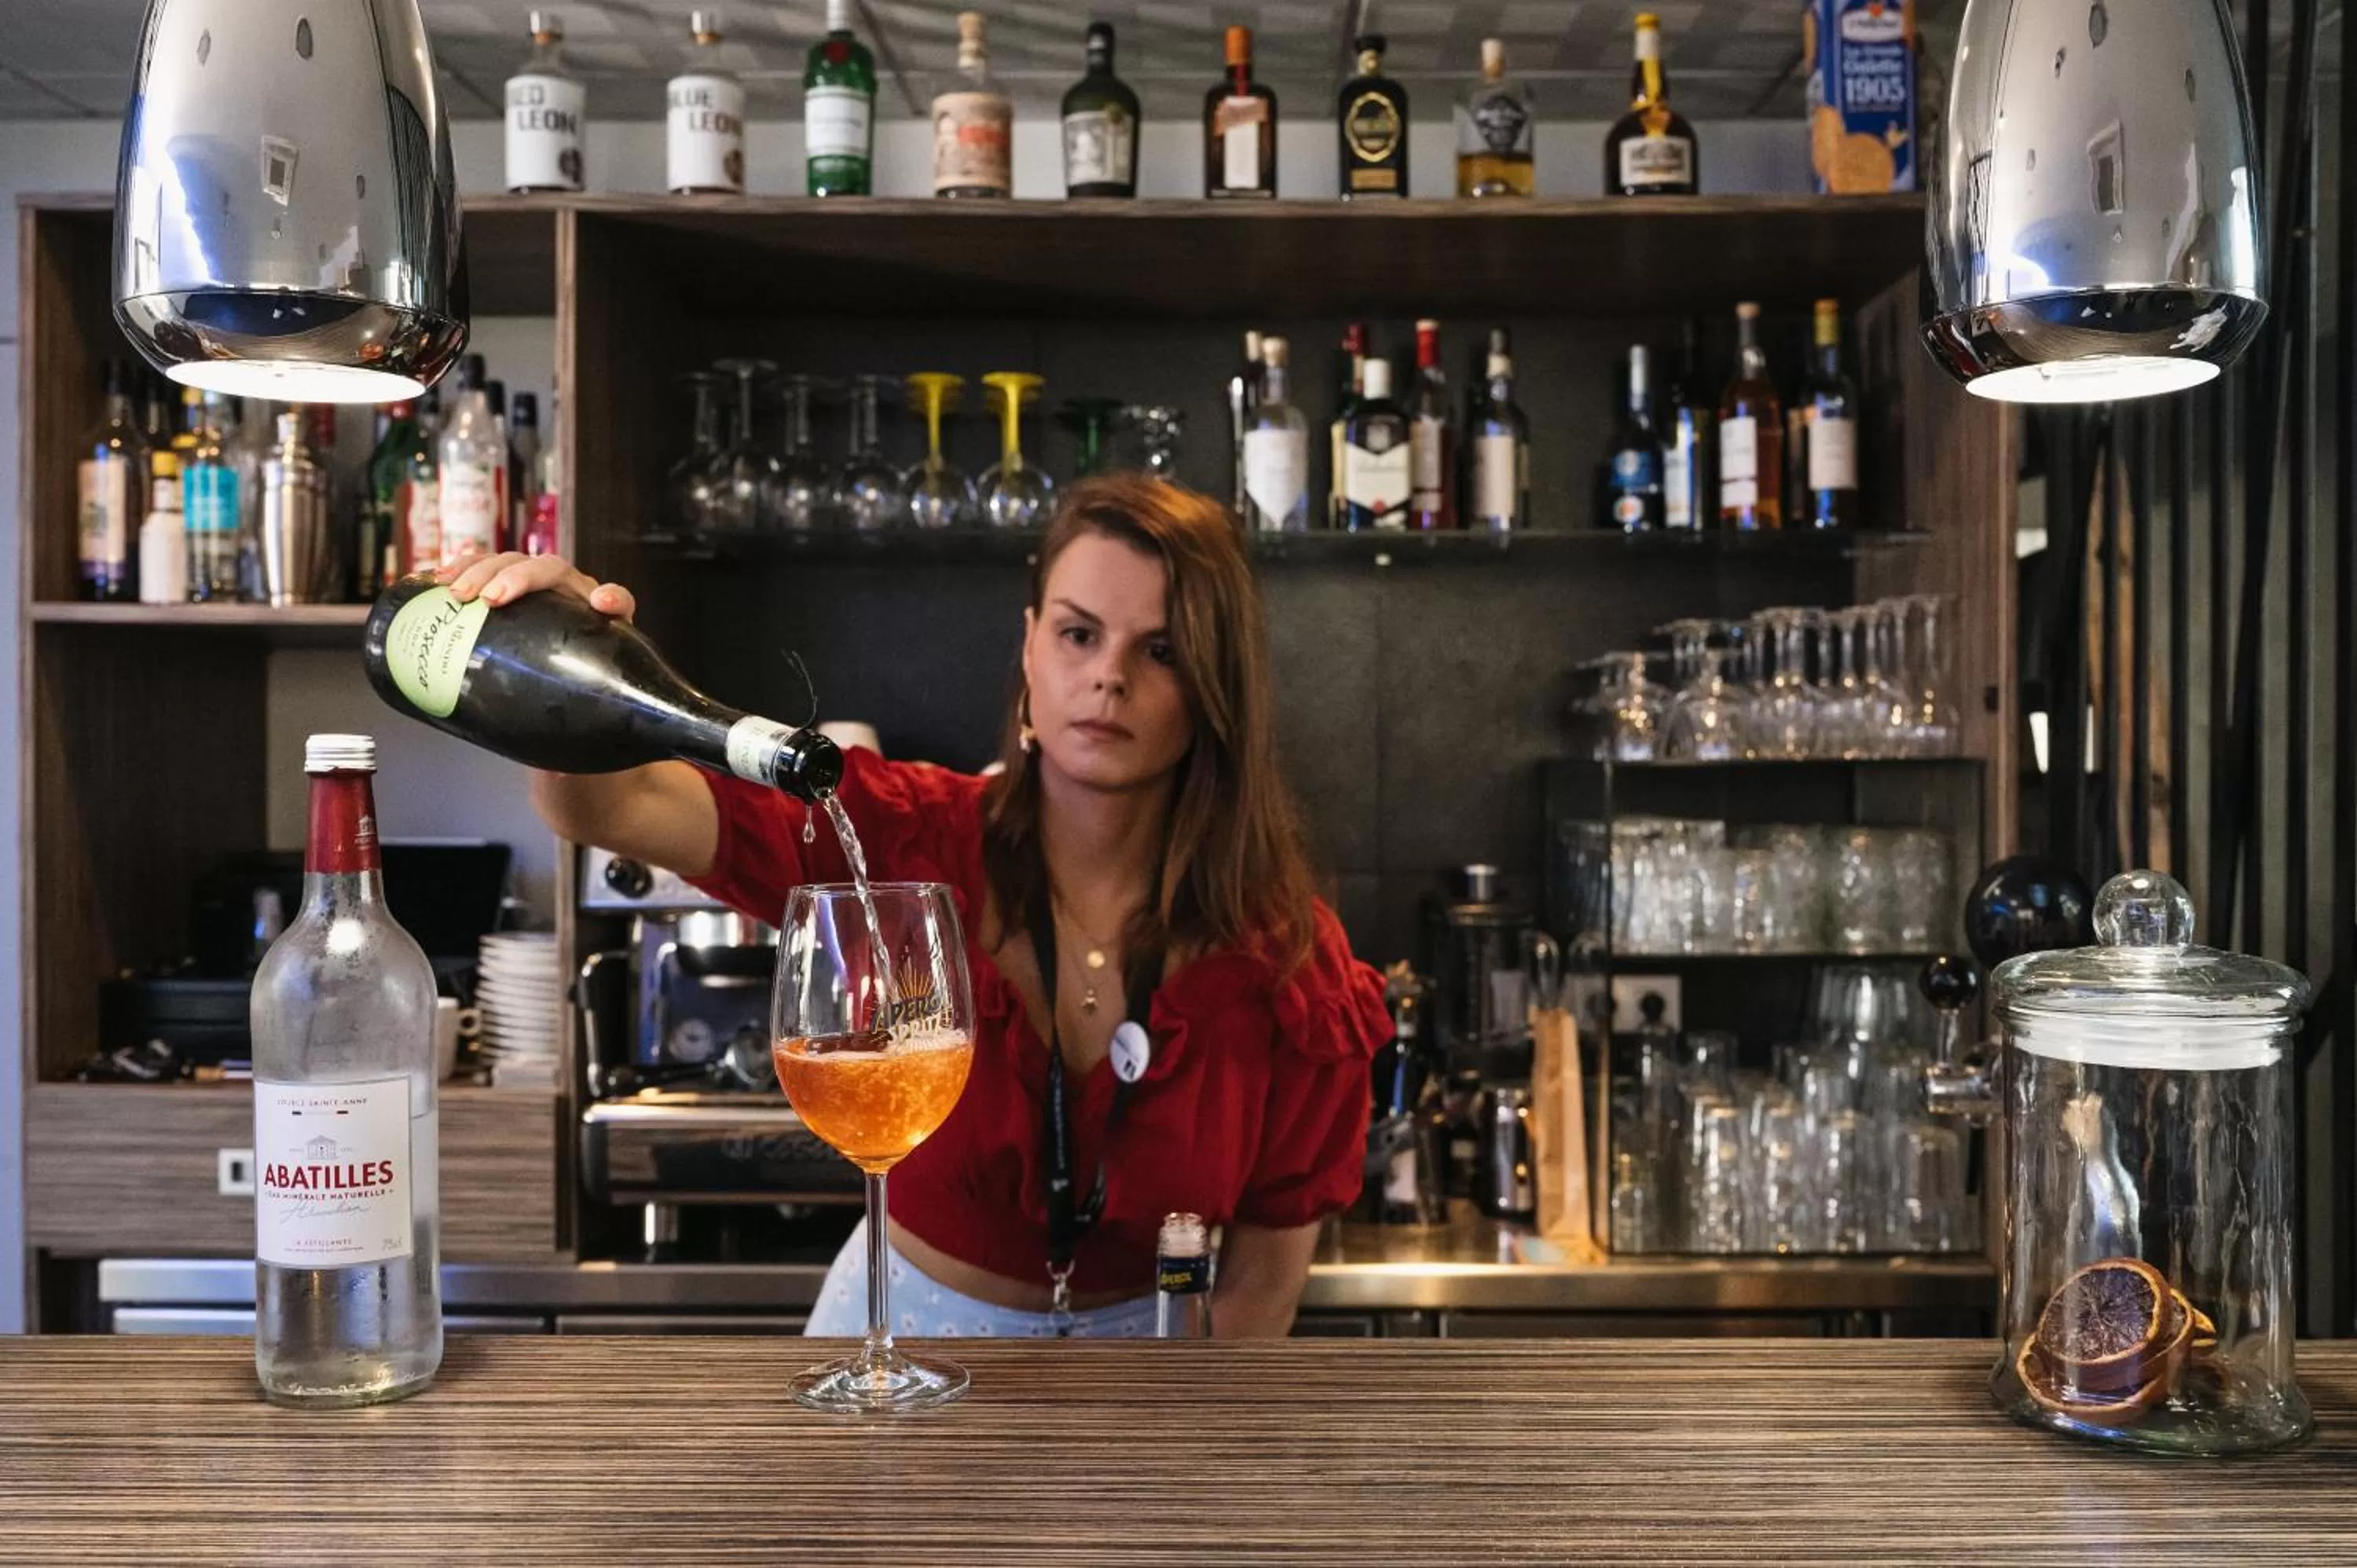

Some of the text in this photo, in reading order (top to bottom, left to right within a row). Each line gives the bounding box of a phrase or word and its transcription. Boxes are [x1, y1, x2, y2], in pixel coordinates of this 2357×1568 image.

[1846, 76, 1905, 104] 1905
[264, 1160, 394, 1190] ABATILLES
[330, 1189, 385, 1200] NATURELLE
